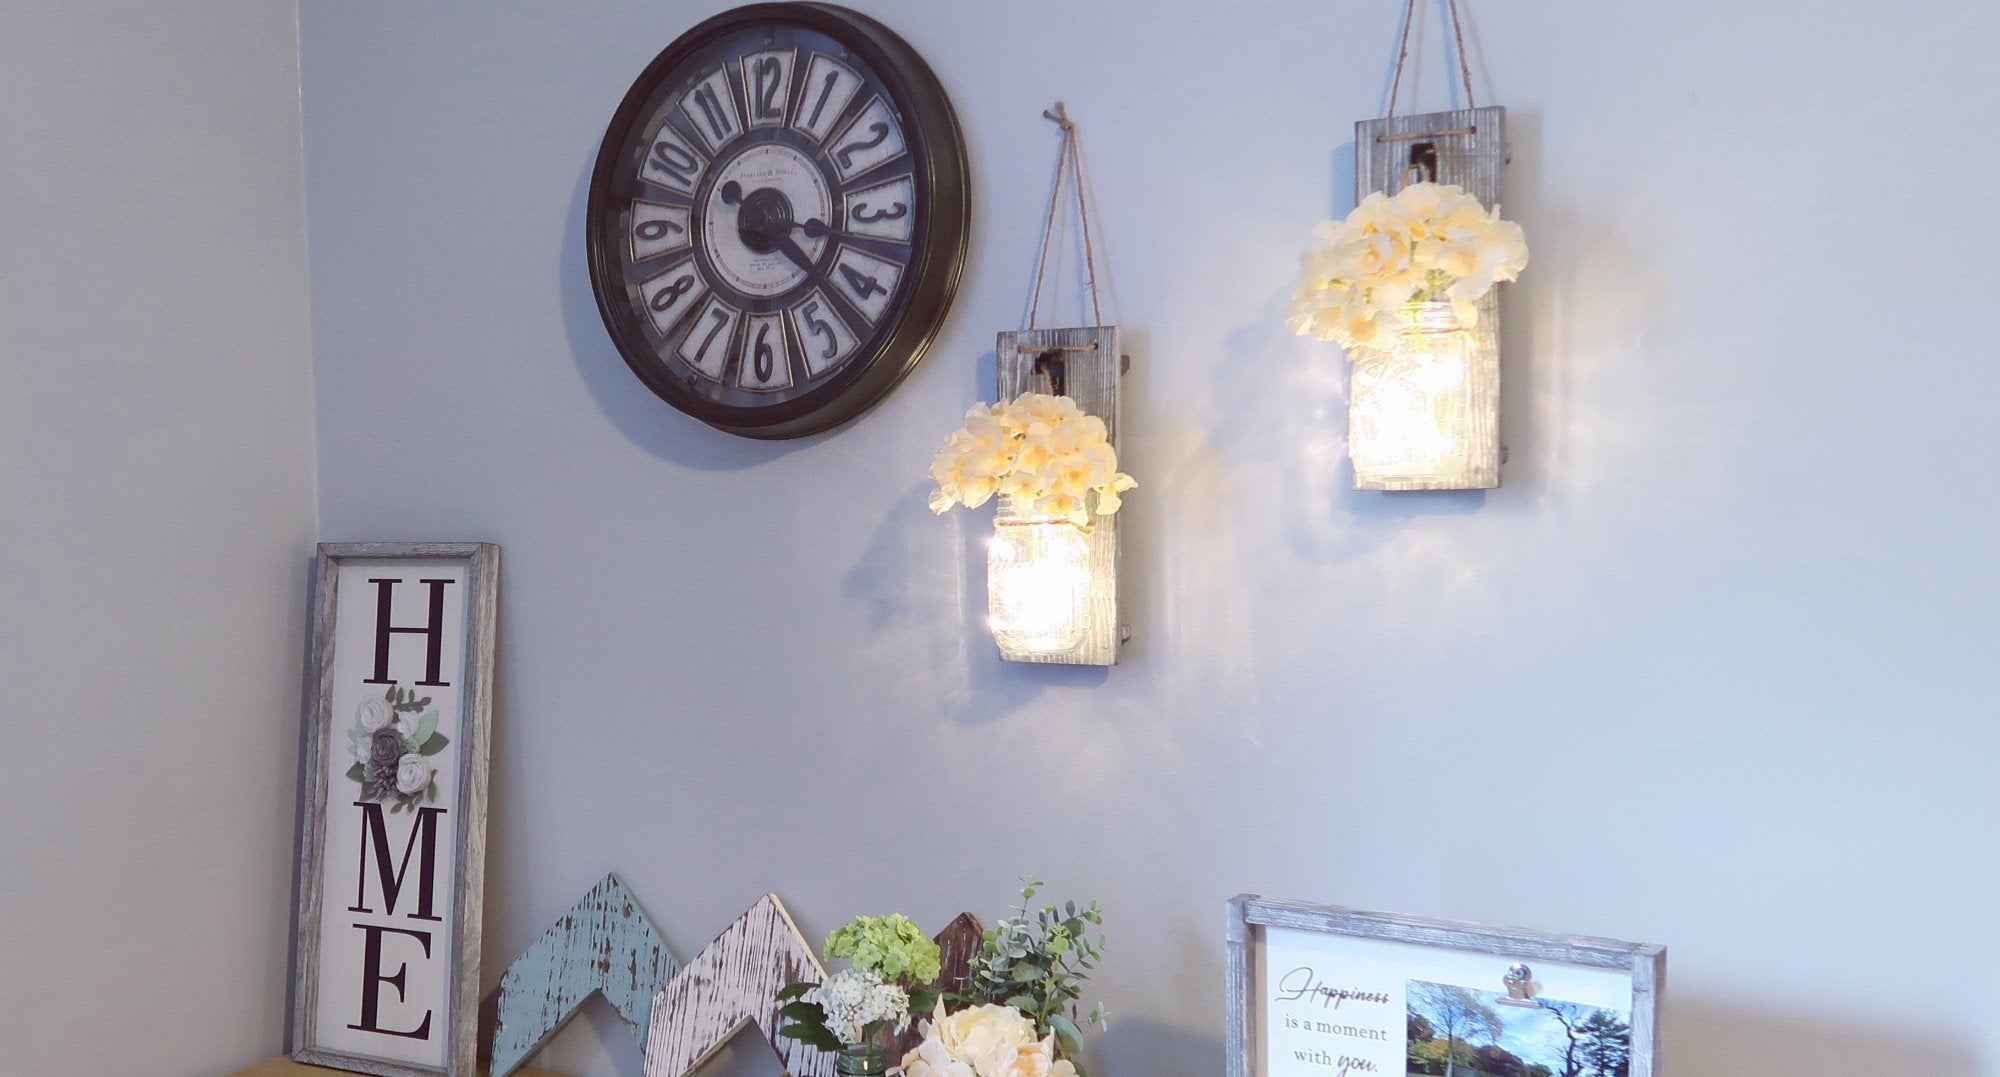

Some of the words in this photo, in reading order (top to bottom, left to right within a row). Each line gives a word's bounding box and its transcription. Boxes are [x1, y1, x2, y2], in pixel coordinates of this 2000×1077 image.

[754, 57, 781, 119] 12
[807, 70, 839, 129] 1
[694, 82, 732, 140] 11
[648, 141, 697, 188] 10
[838, 123, 889, 167] 2
[635, 219, 683, 241] 9
[851, 202, 907, 224] 3
[651, 274, 695, 312] 8
[838, 263, 887, 299] 4
[694, 307, 729, 362] 7
[802, 301, 838, 359] 5
[754, 323, 773, 383] 6
[347, 578, 455, 1040] HME
[1275, 966, 1389, 1010] Happiness
[1285, 1013, 1298, 1029] is
[1303, 1020, 1312, 1031] a
[1316, 1021, 1387, 1041] moment
[1294, 1049, 1331, 1066] with
[1337, 1054, 1378, 1077] you.
